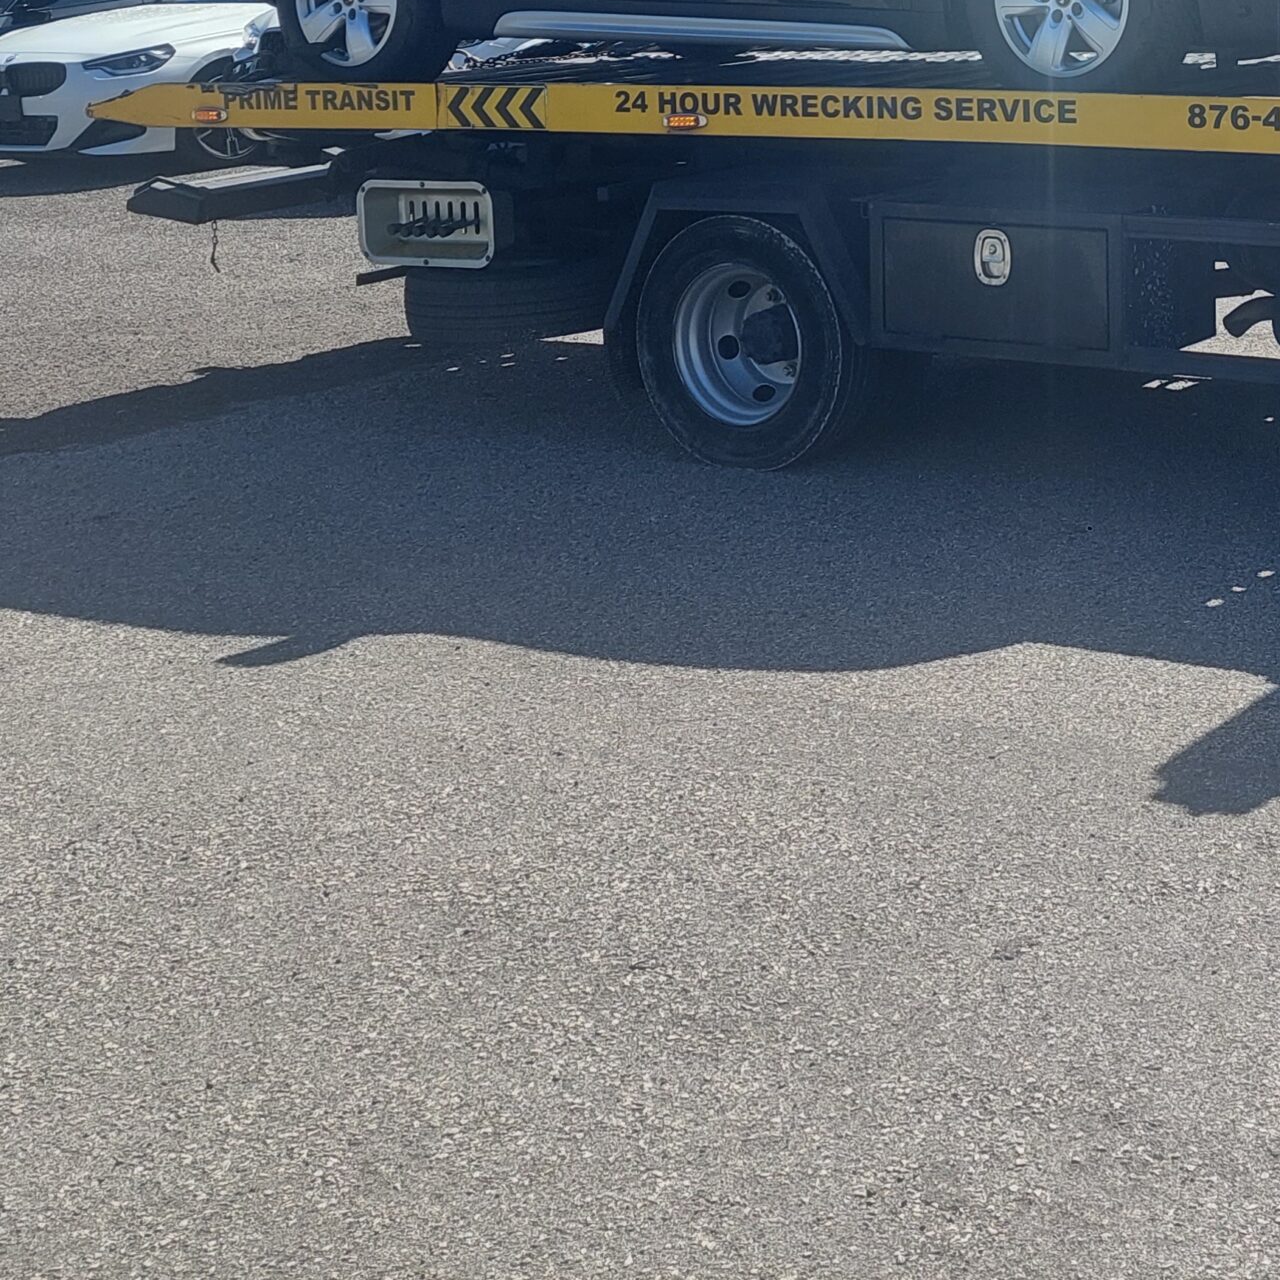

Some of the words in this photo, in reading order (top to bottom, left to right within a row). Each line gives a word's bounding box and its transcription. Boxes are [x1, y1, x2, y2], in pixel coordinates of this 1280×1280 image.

[223, 86, 299, 111] PRIME
[305, 89, 416, 112] TRANSIT
[614, 90, 649, 114] 24
[657, 91, 744, 117] HOUR
[751, 93, 924, 121] WRECKING
[933, 96, 1078, 124] SERVICE
